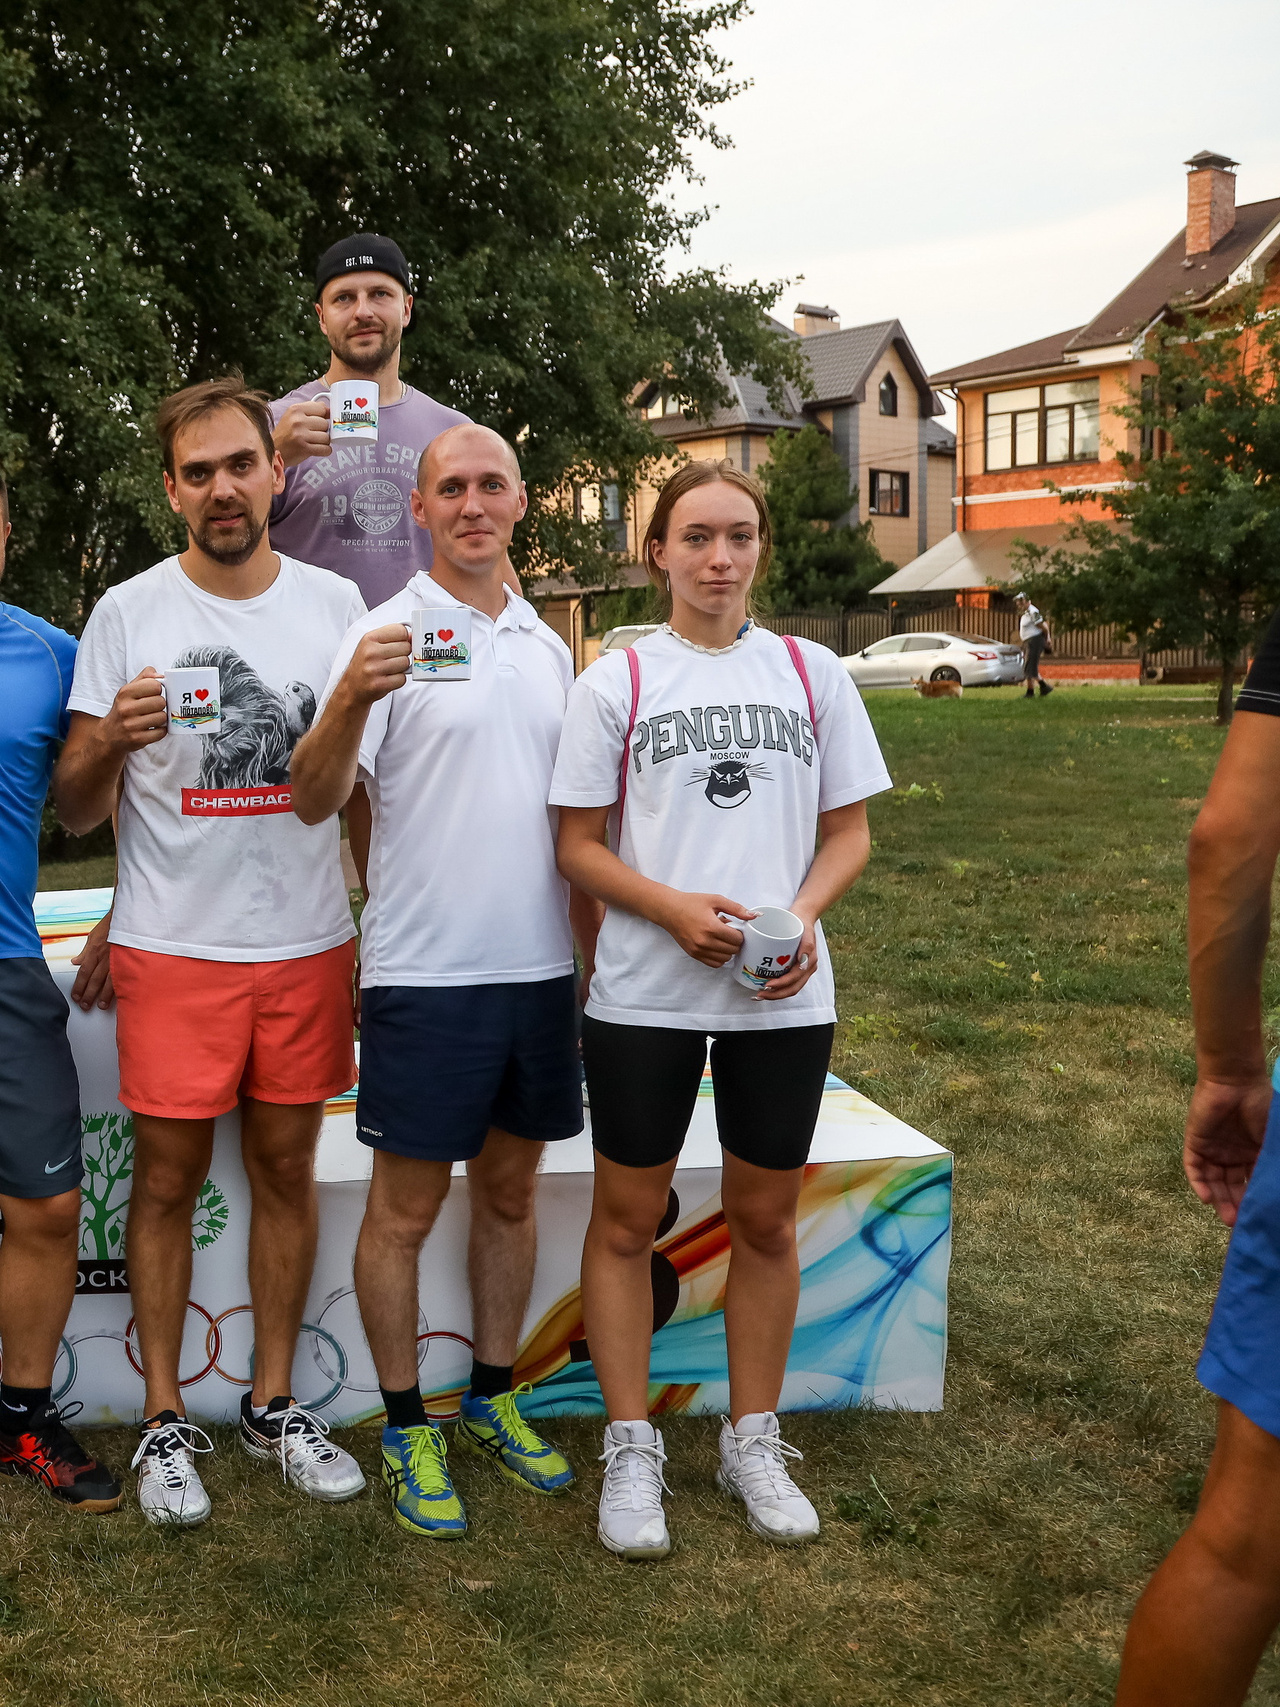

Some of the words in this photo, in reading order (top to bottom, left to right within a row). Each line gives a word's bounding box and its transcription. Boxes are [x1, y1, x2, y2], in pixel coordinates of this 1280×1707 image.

[343, 400, 352, 410] Я
[302, 443, 377, 490] BRAVE
[341, 539, 375, 547] SPECIAL
[378, 539, 411, 547] EDITION
[424, 632, 434, 645] Я
[182, 692, 192, 704] Я
[631, 704, 815, 774] PENGUINS
[710, 751, 750, 761] MOSCOW
[190, 793, 291, 809] CHEWBAC
[761, 957, 773, 967] Я
